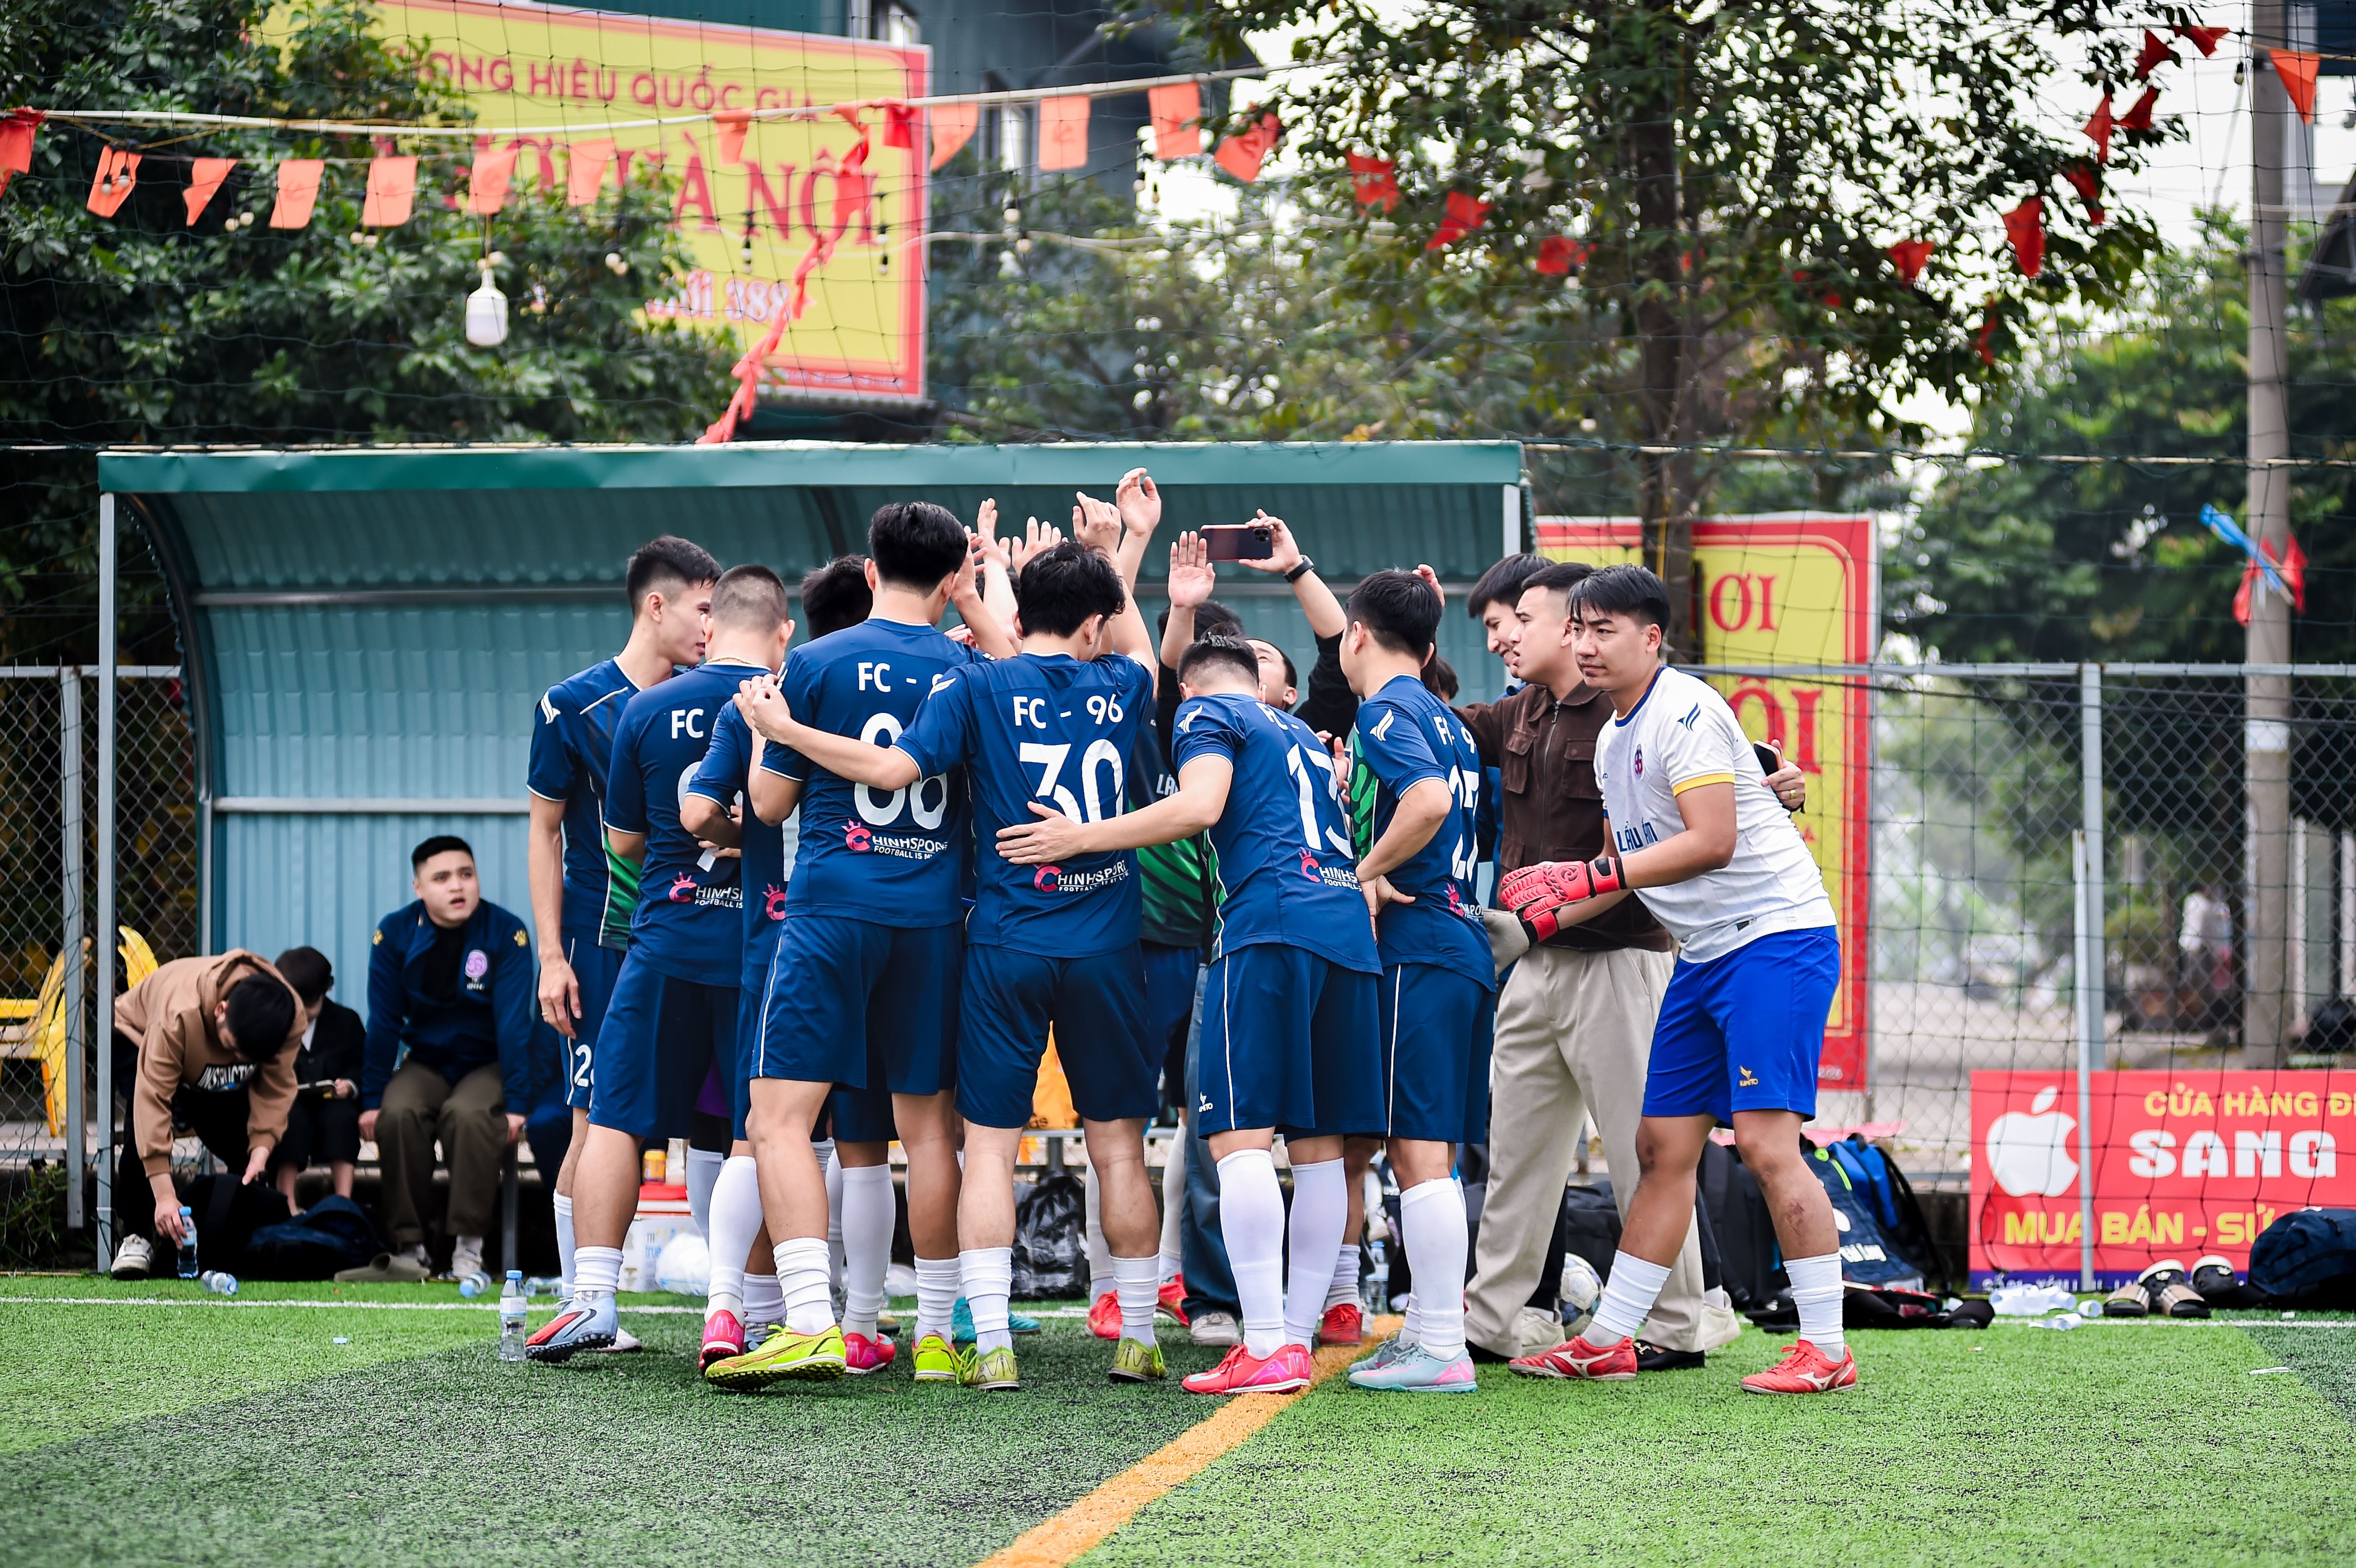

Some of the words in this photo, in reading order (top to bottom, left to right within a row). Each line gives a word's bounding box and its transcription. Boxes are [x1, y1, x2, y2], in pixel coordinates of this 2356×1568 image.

[530, 58, 617, 108] HIỆU
[630, 64, 743, 110] QUỐC
[859, 662, 891, 692] FC
[671, 708, 704, 739] FC
[1014, 696, 1046, 728] FC
[1086, 693, 1124, 725] 96
[1019, 739, 1124, 825] 30
[574, 1044, 595, 1088] 2
[2144, 1082, 2215, 1117] CỬA
[2224, 1086, 2318, 1117] HÀNG
[2129, 1129, 2337, 1178] SANG
[2101, 1204, 2184, 1245] BÁN
